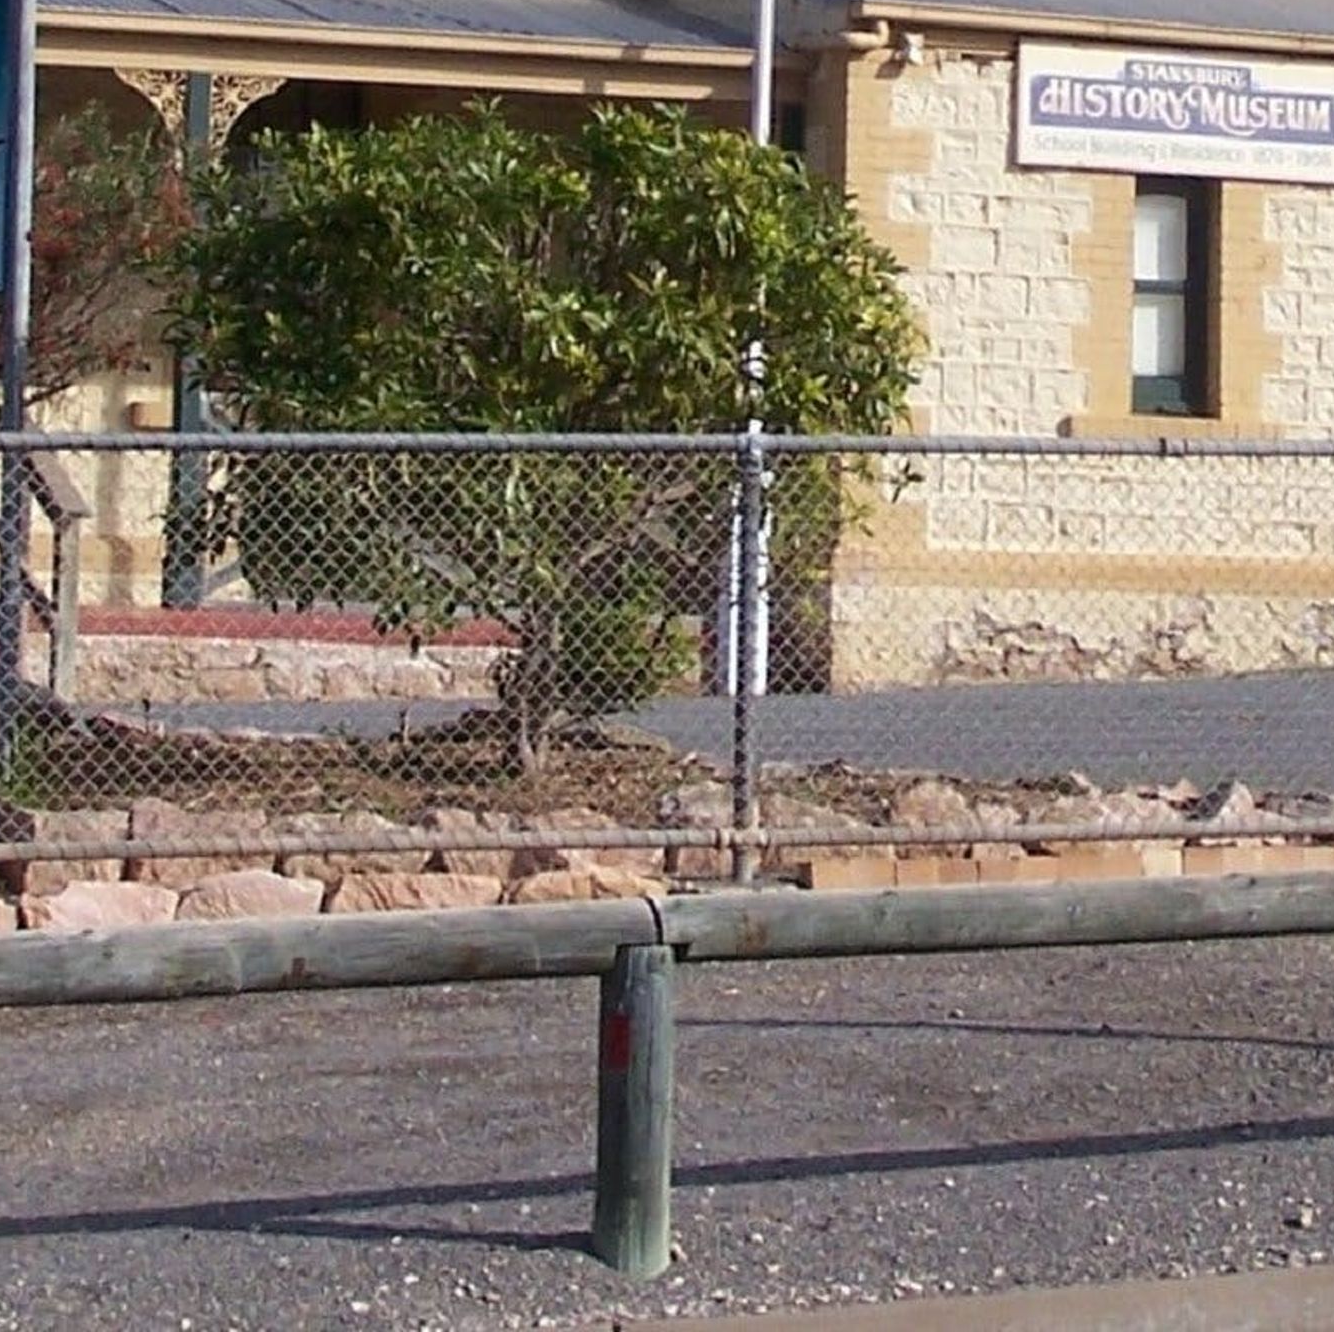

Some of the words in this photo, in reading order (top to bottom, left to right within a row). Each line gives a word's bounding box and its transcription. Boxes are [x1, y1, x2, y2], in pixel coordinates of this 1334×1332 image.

[1131, 64, 1245, 88] STANSBURY
[1038, 78, 1190, 131] HISTORY
[1187, 84, 1330, 137] MUSEUM
[1034, 132, 1087, 153] School
[1090, 135, 1156, 163] Building
